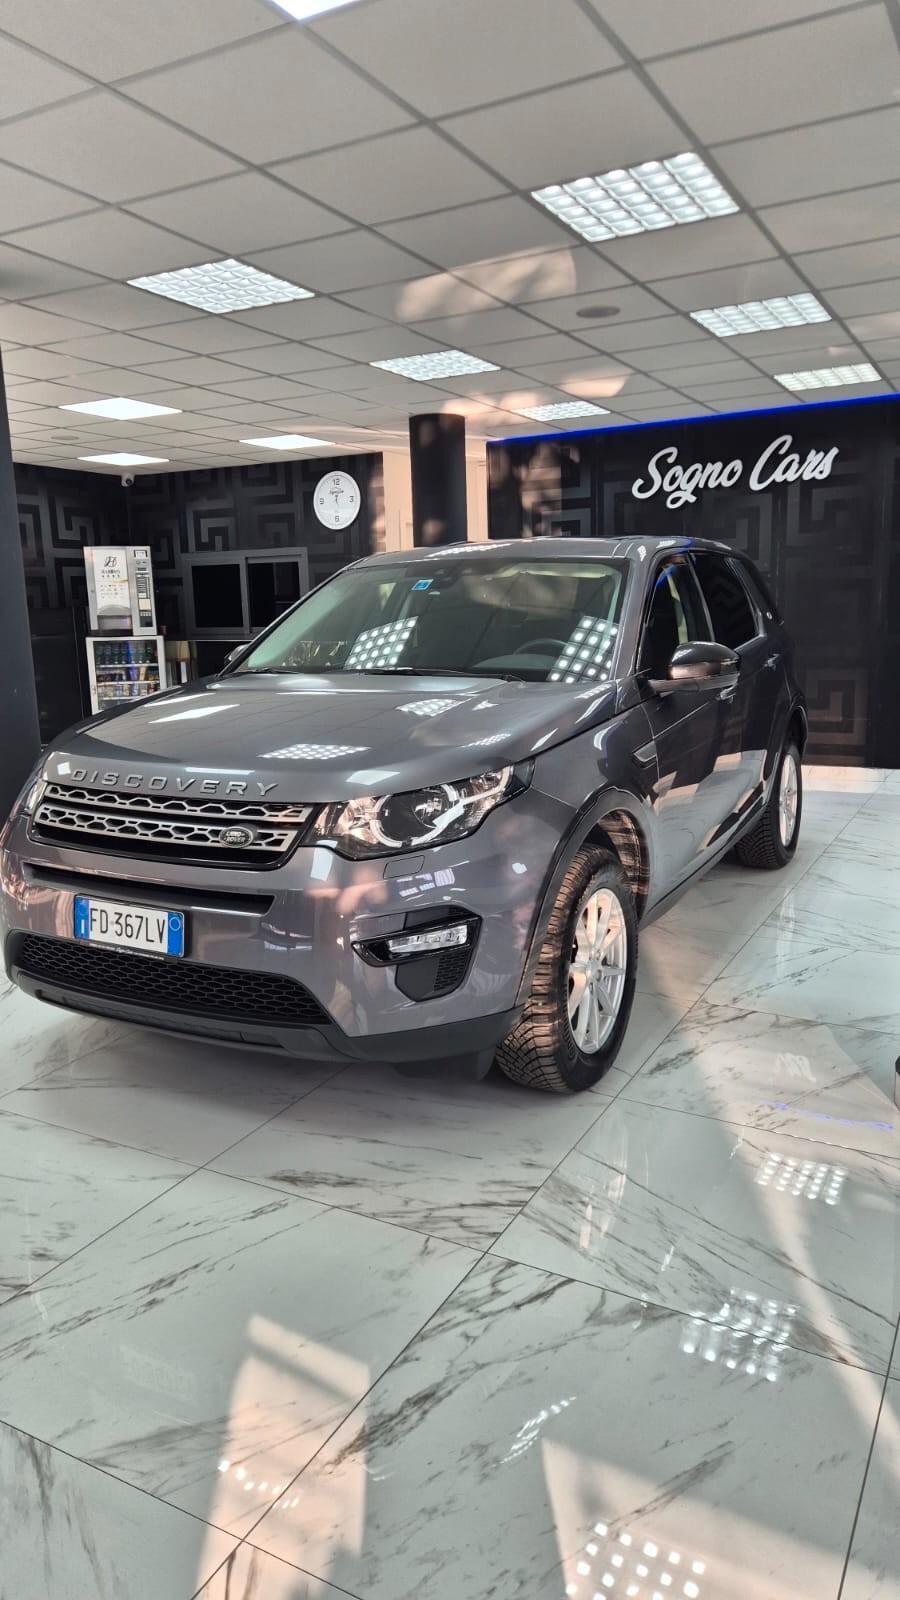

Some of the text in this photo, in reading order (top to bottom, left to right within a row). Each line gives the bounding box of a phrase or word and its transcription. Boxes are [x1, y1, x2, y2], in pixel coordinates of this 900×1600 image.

[333, 478, 340, 486] 12
[632, 434, 839, 509] Sogno Cars
[71, 768, 278, 797] DISCOVERY
